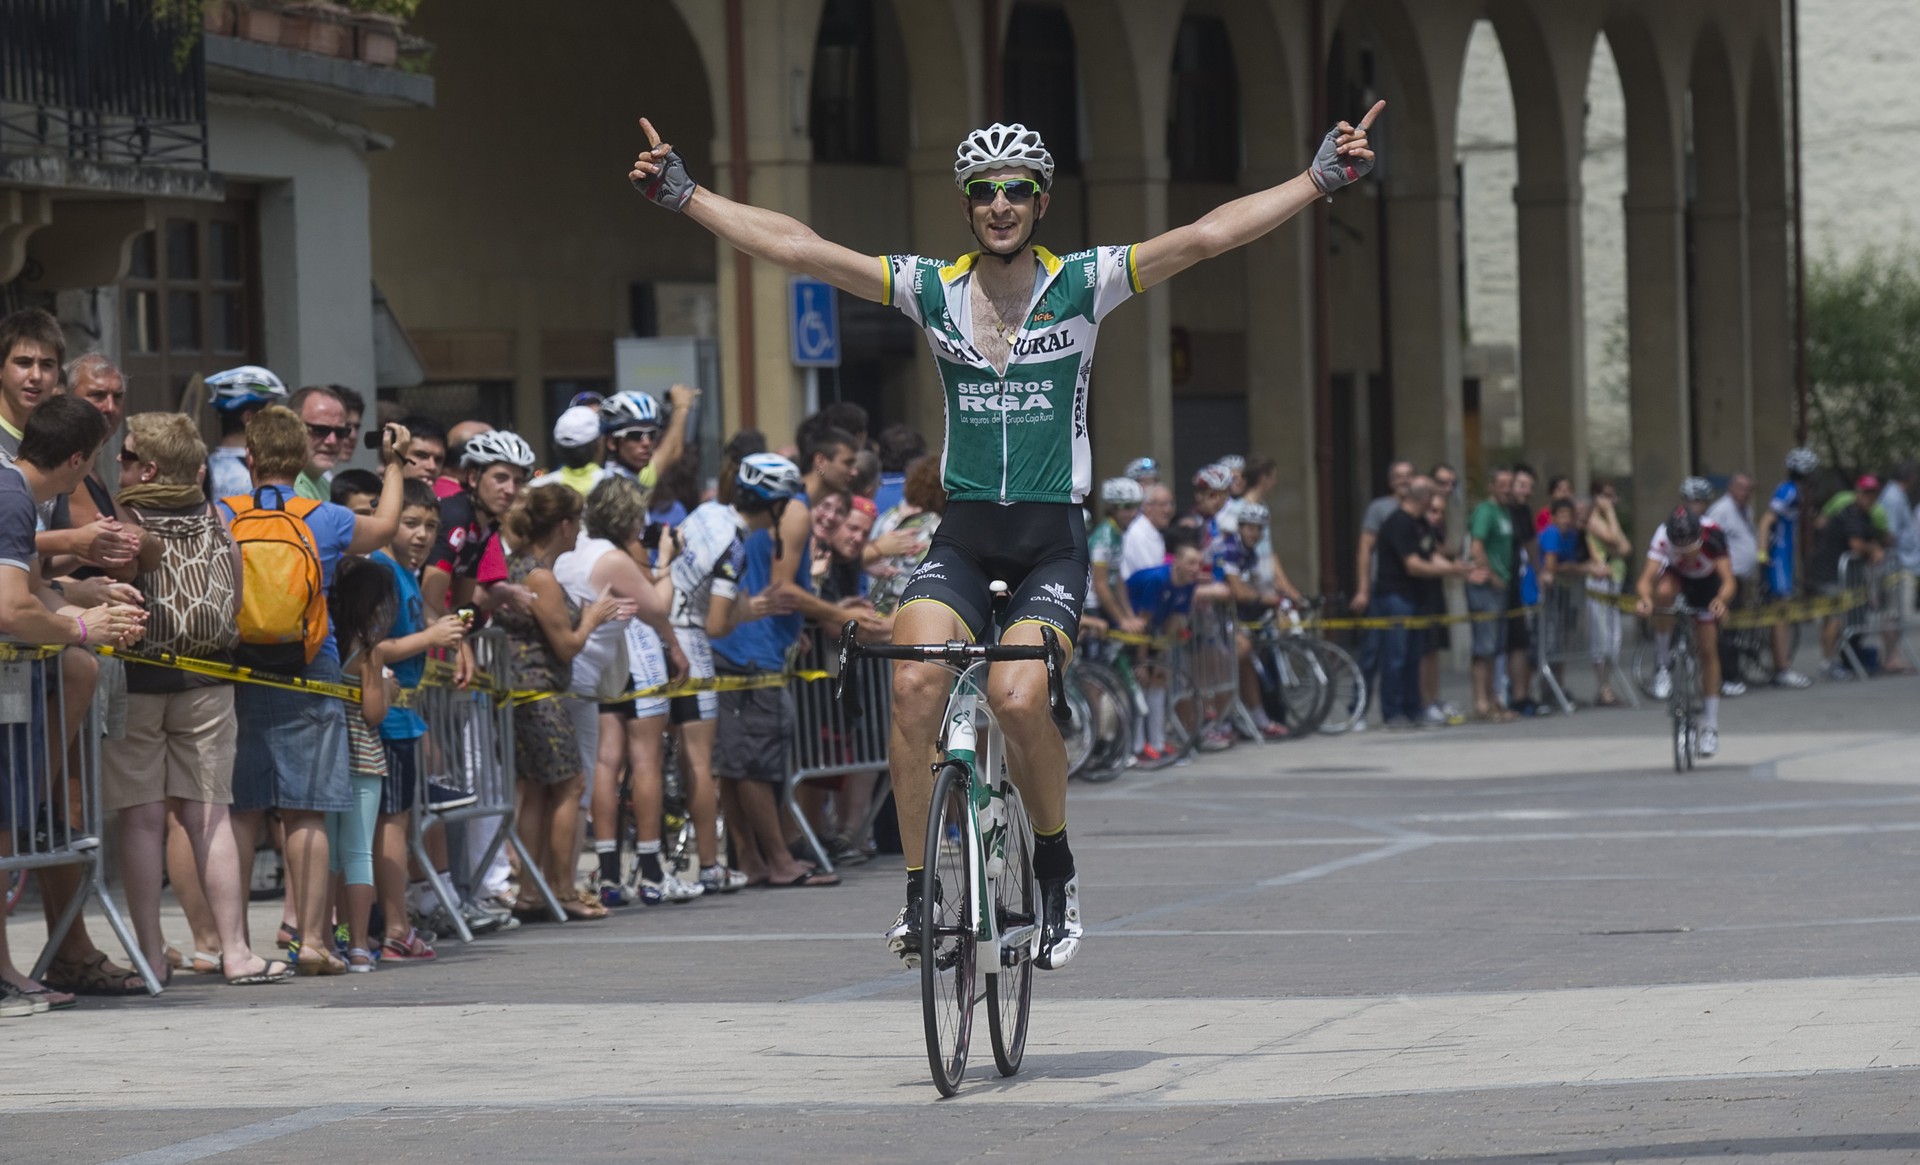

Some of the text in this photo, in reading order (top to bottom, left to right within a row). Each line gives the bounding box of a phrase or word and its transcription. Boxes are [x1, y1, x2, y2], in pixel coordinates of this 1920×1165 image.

[957, 380, 1054, 394] SEGUROS
[958, 393, 1053, 412] RGA
[991, 411, 1002, 423] del
[1005, 414, 1025, 426] Grupo
[1025, 412, 1040, 425] Caja
[1040, 410, 1055, 421] Rural
[1074, 387, 1083, 440] RGA
[1054, 599, 1078, 621] RURAL
